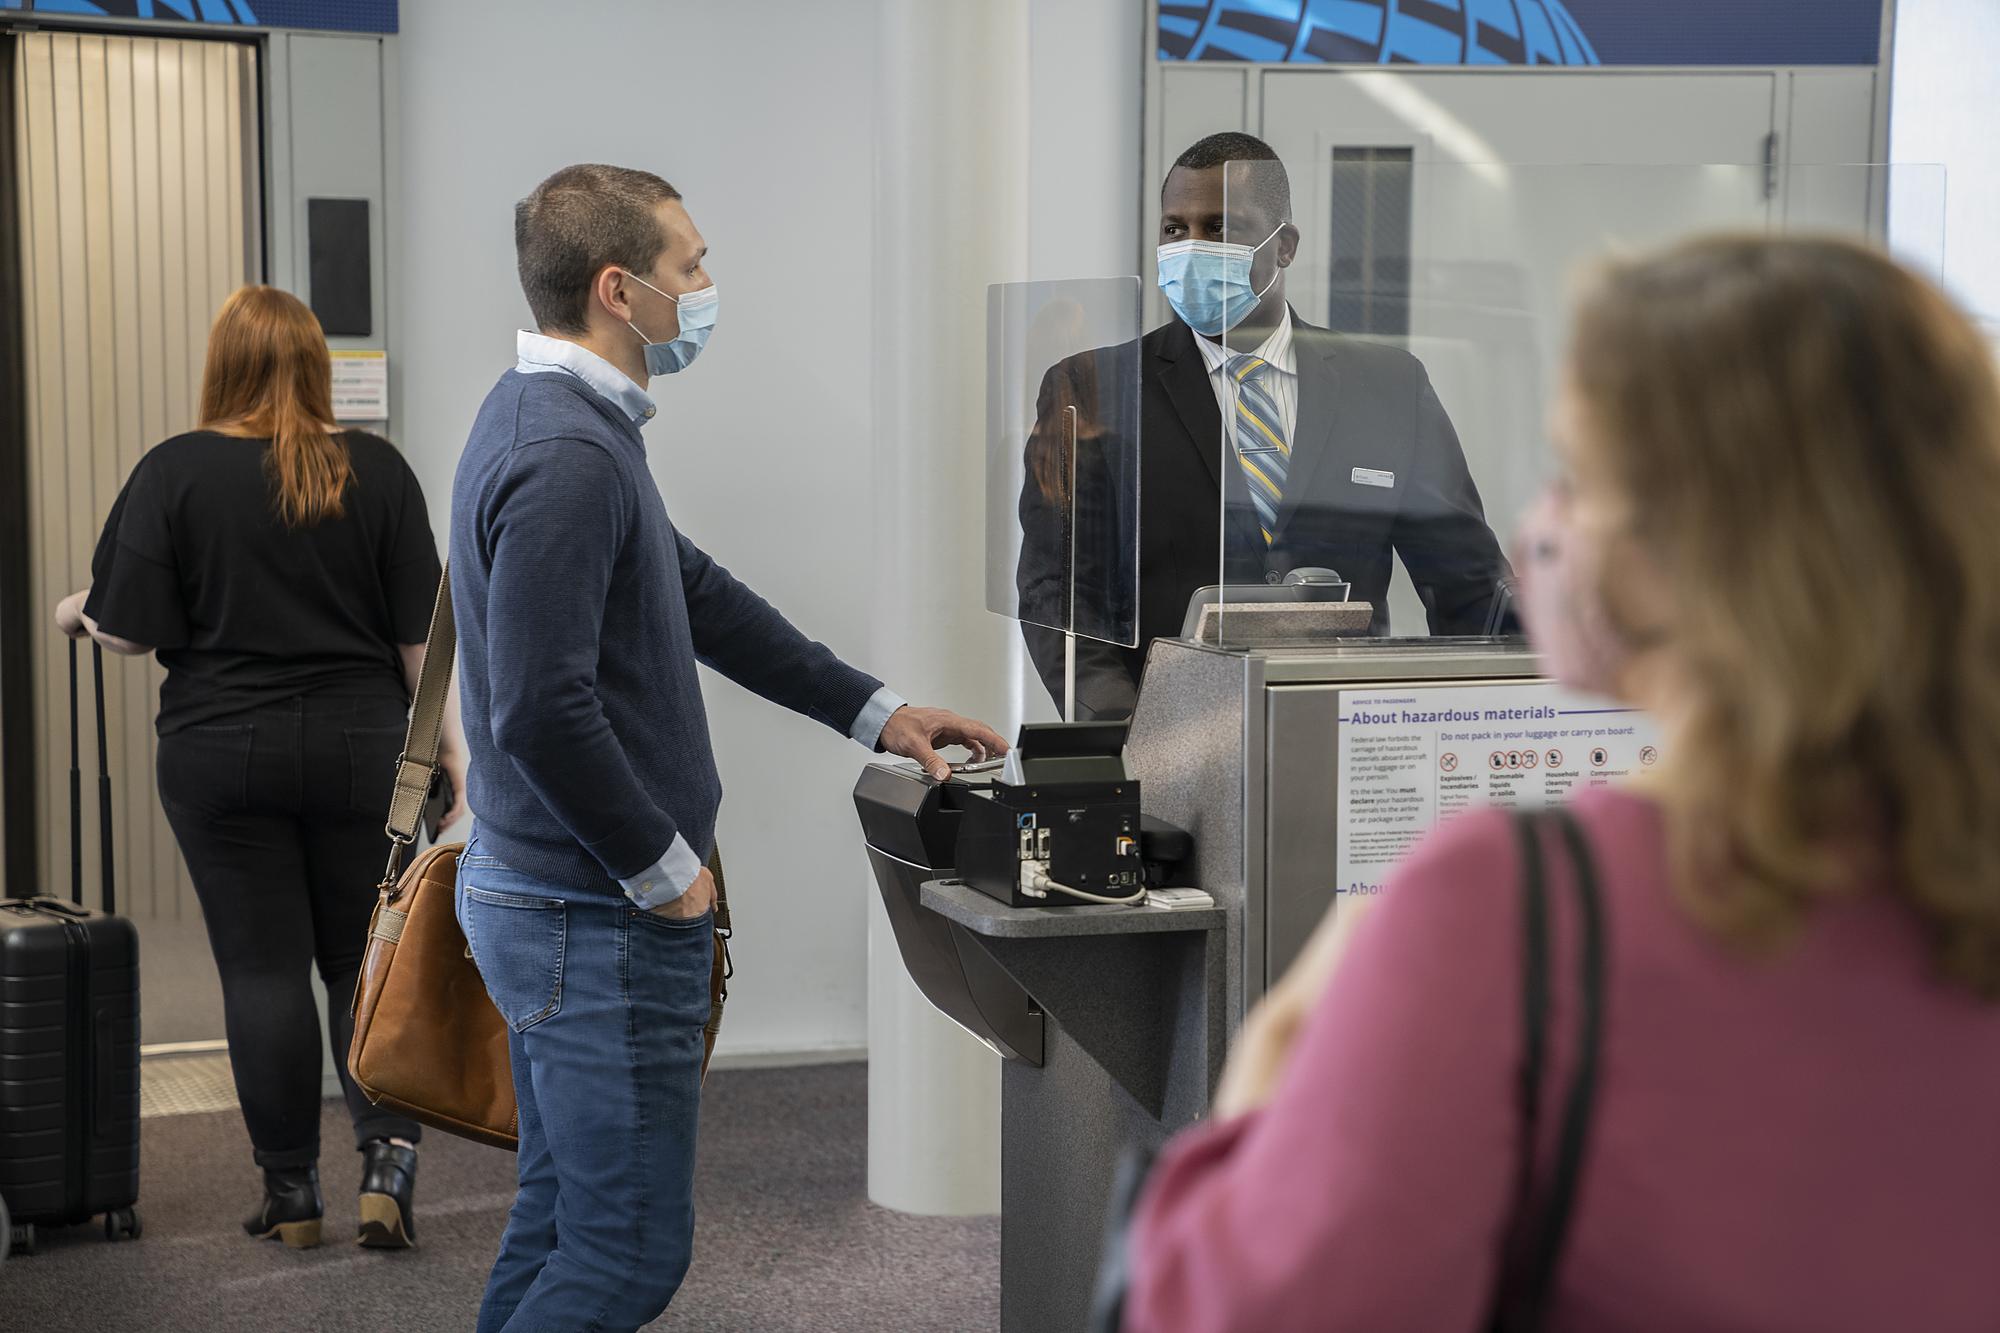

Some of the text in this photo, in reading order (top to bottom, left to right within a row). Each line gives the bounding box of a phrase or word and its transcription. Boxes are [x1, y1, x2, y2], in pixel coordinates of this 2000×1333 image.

[1351, 705, 1556, 725] About hazardous materials
[1440, 732, 1453, 741] Do
[1455, 731, 1469, 741] not
[1471, 731, 1491, 742] pack
[1493, 731, 1501, 739] in
[1503, 731, 1523, 741] your
[1525, 729, 1558, 740] luggage
[1571, 728, 1593, 738] carry
[1595, 728, 1606, 736] on
[1608, 726, 1635, 735] board:
[1374, 764, 1398, 772] luggage
[1590, 769, 1629, 777] Compressed
[1367, 816, 1393, 824] package
